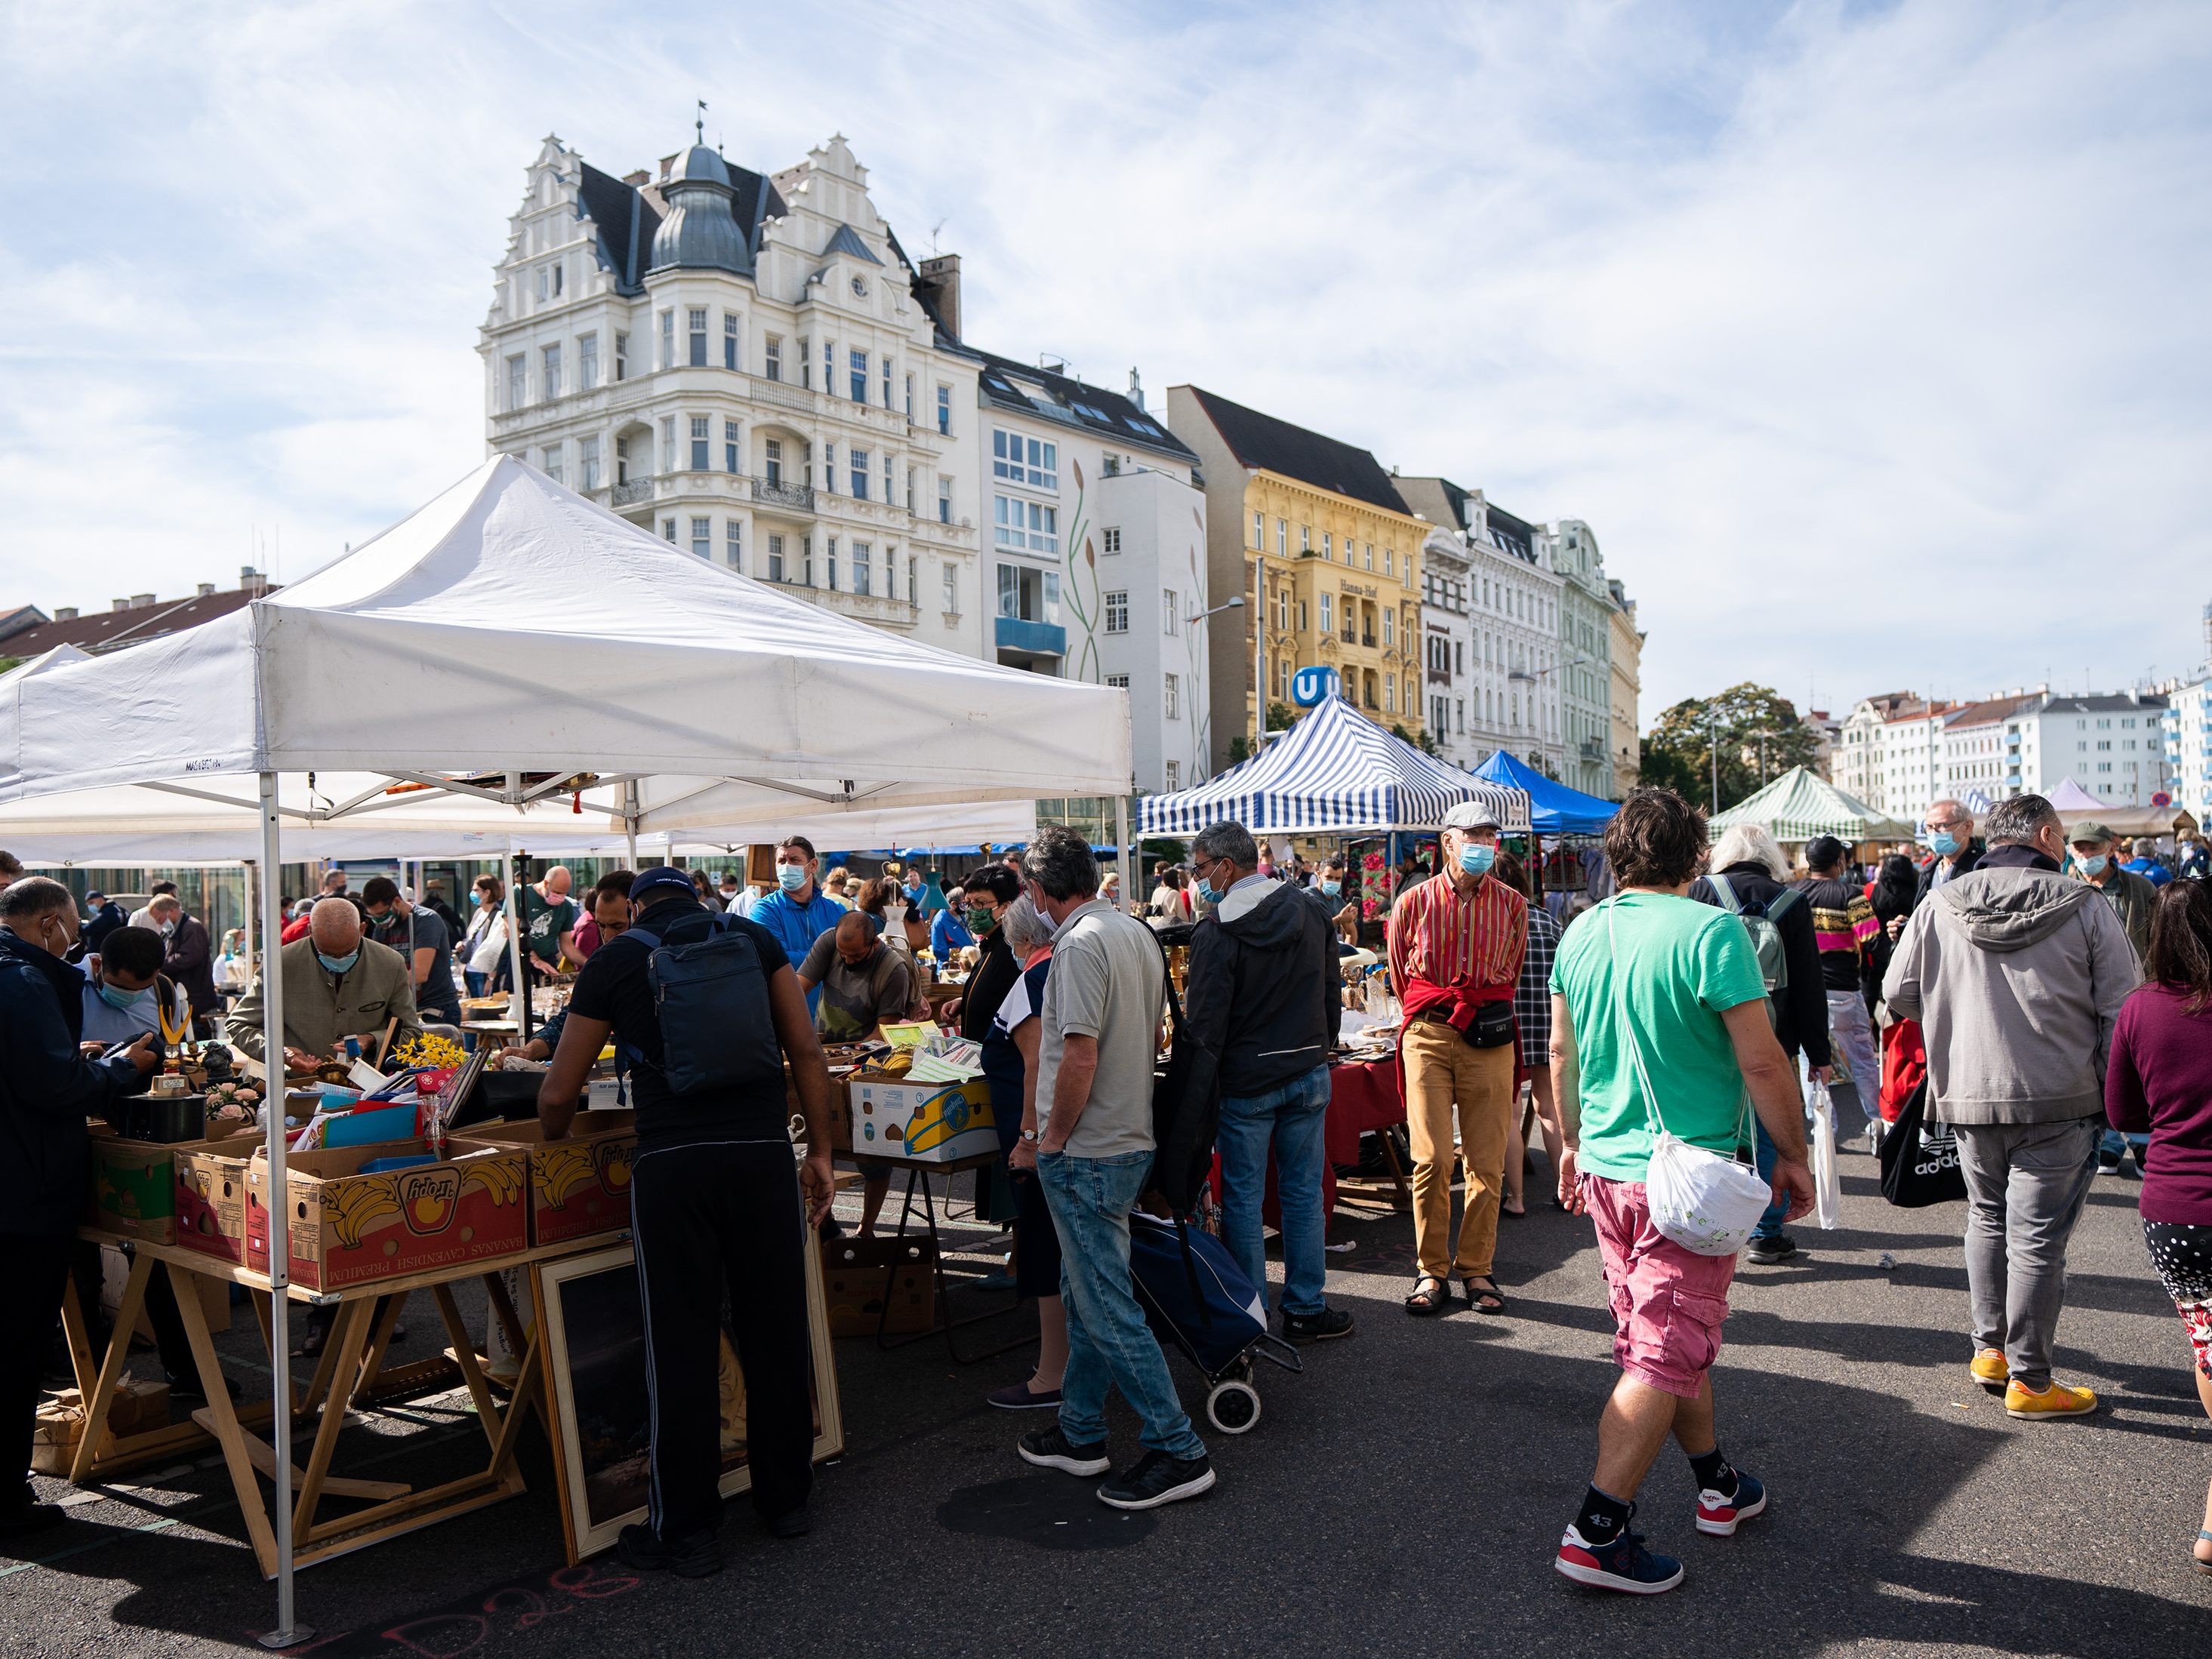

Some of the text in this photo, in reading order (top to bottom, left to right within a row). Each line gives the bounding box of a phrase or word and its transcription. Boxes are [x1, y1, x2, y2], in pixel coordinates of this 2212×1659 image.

[1340, 577, 1379, 599] Hanna-Hof
[1297, 674, 1317, 700] U
[1326, 674, 1340, 696] U
[942, 1094, 965, 1119] Chiquita
[405, 1176, 454, 1204] Tropy
[539, 1219, 590, 1240] PREMIUM
[328, 1236, 523, 1283] BANANAS CAVENDISH PREMIUM
[2053, 1393, 2073, 1410] N
[1715, 1462, 1729, 1479] 43
[1588, 1513, 1613, 1528] 43
